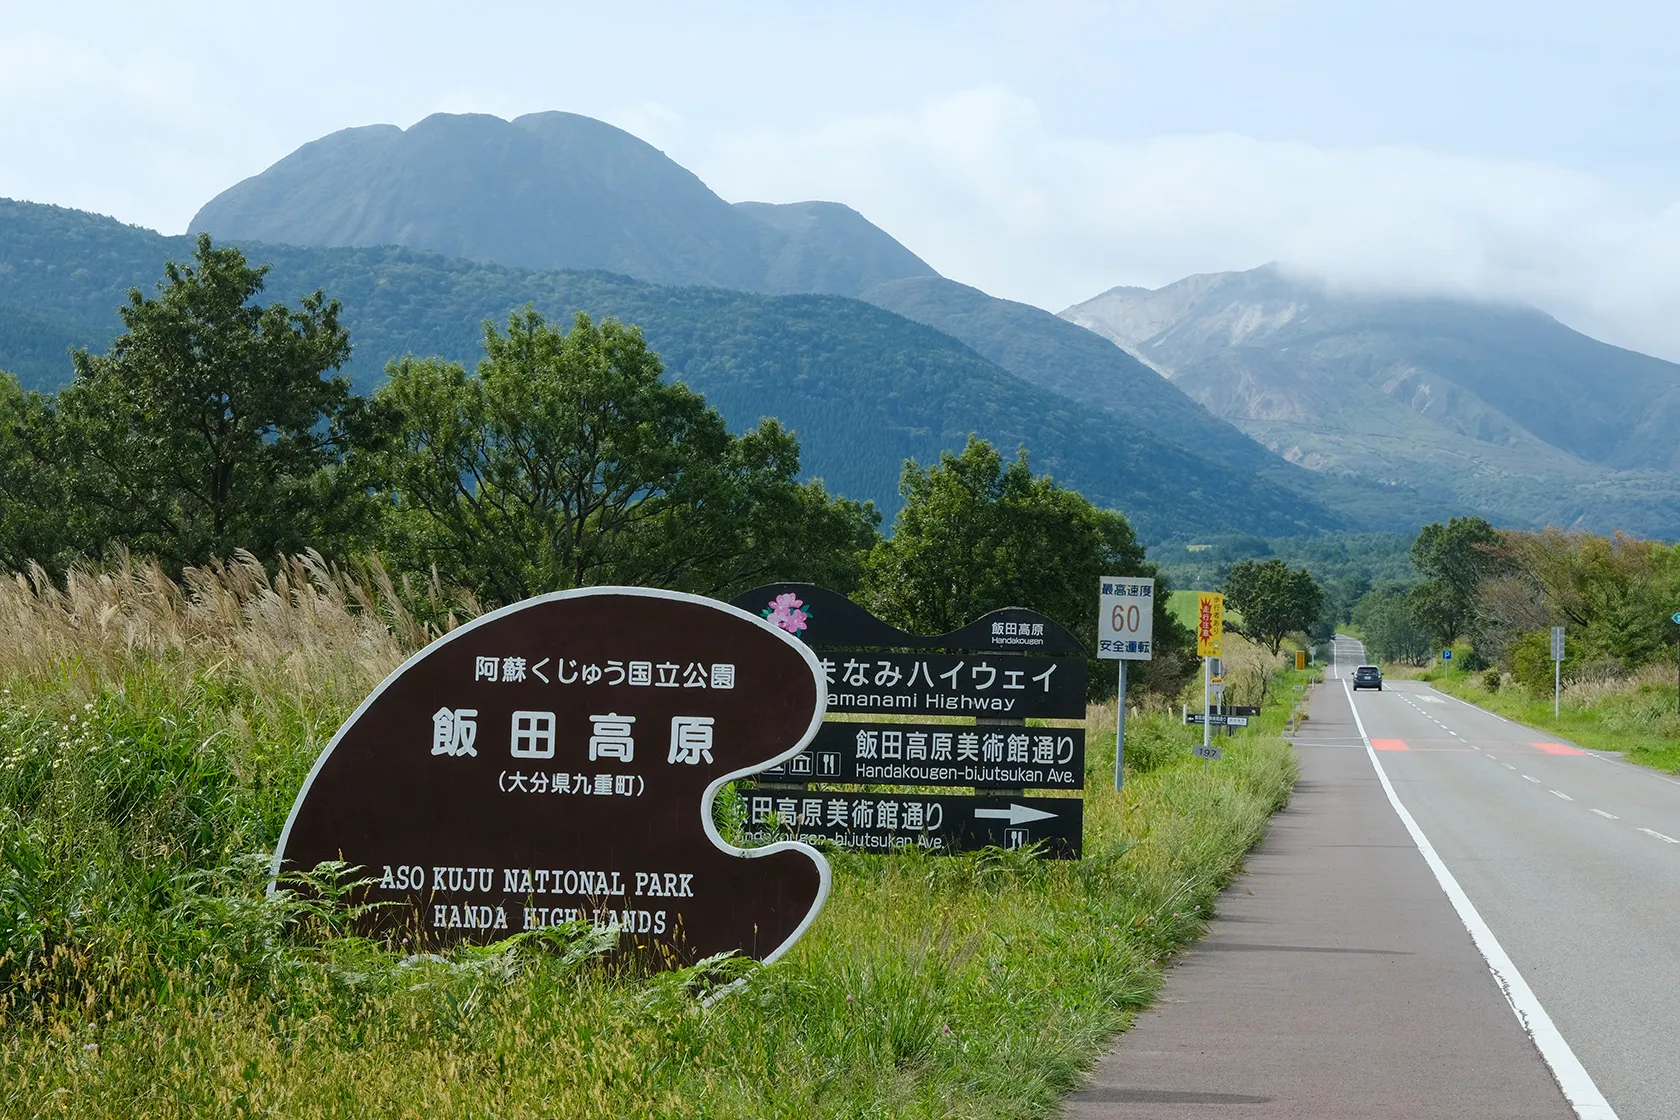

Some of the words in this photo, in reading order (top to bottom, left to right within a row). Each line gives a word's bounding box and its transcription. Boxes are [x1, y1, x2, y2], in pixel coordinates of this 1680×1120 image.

[1101, 583, 1152, 597] 最高速度
[991, 621, 1044, 636] 飯田高原
[1111, 604, 1140, 633] 60
[991, 636, 1044, 645] Handakougen
[1099, 639, 1150, 654] 安全運転
[474, 655, 736, 690] 阿蘇くじゅう国立公園
[926, 694, 1016, 711] Highway
[430, 706, 715, 766] 飯田高原
[855, 729, 1074, 764] 飯田高原美術館通り
[855, 763, 1042, 783] Handakougen-bijutsukan
[1047, 769, 1076, 784] Ave.
[918, 833, 945, 849] Ave.
[379, 865, 425, 890] ASO
[432, 866, 494, 893] KUJU
[503, 869, 625, 896] NATIONAL
[635, 872, 694, 898] PARK
[433, 905, 508, 929] HANDA
